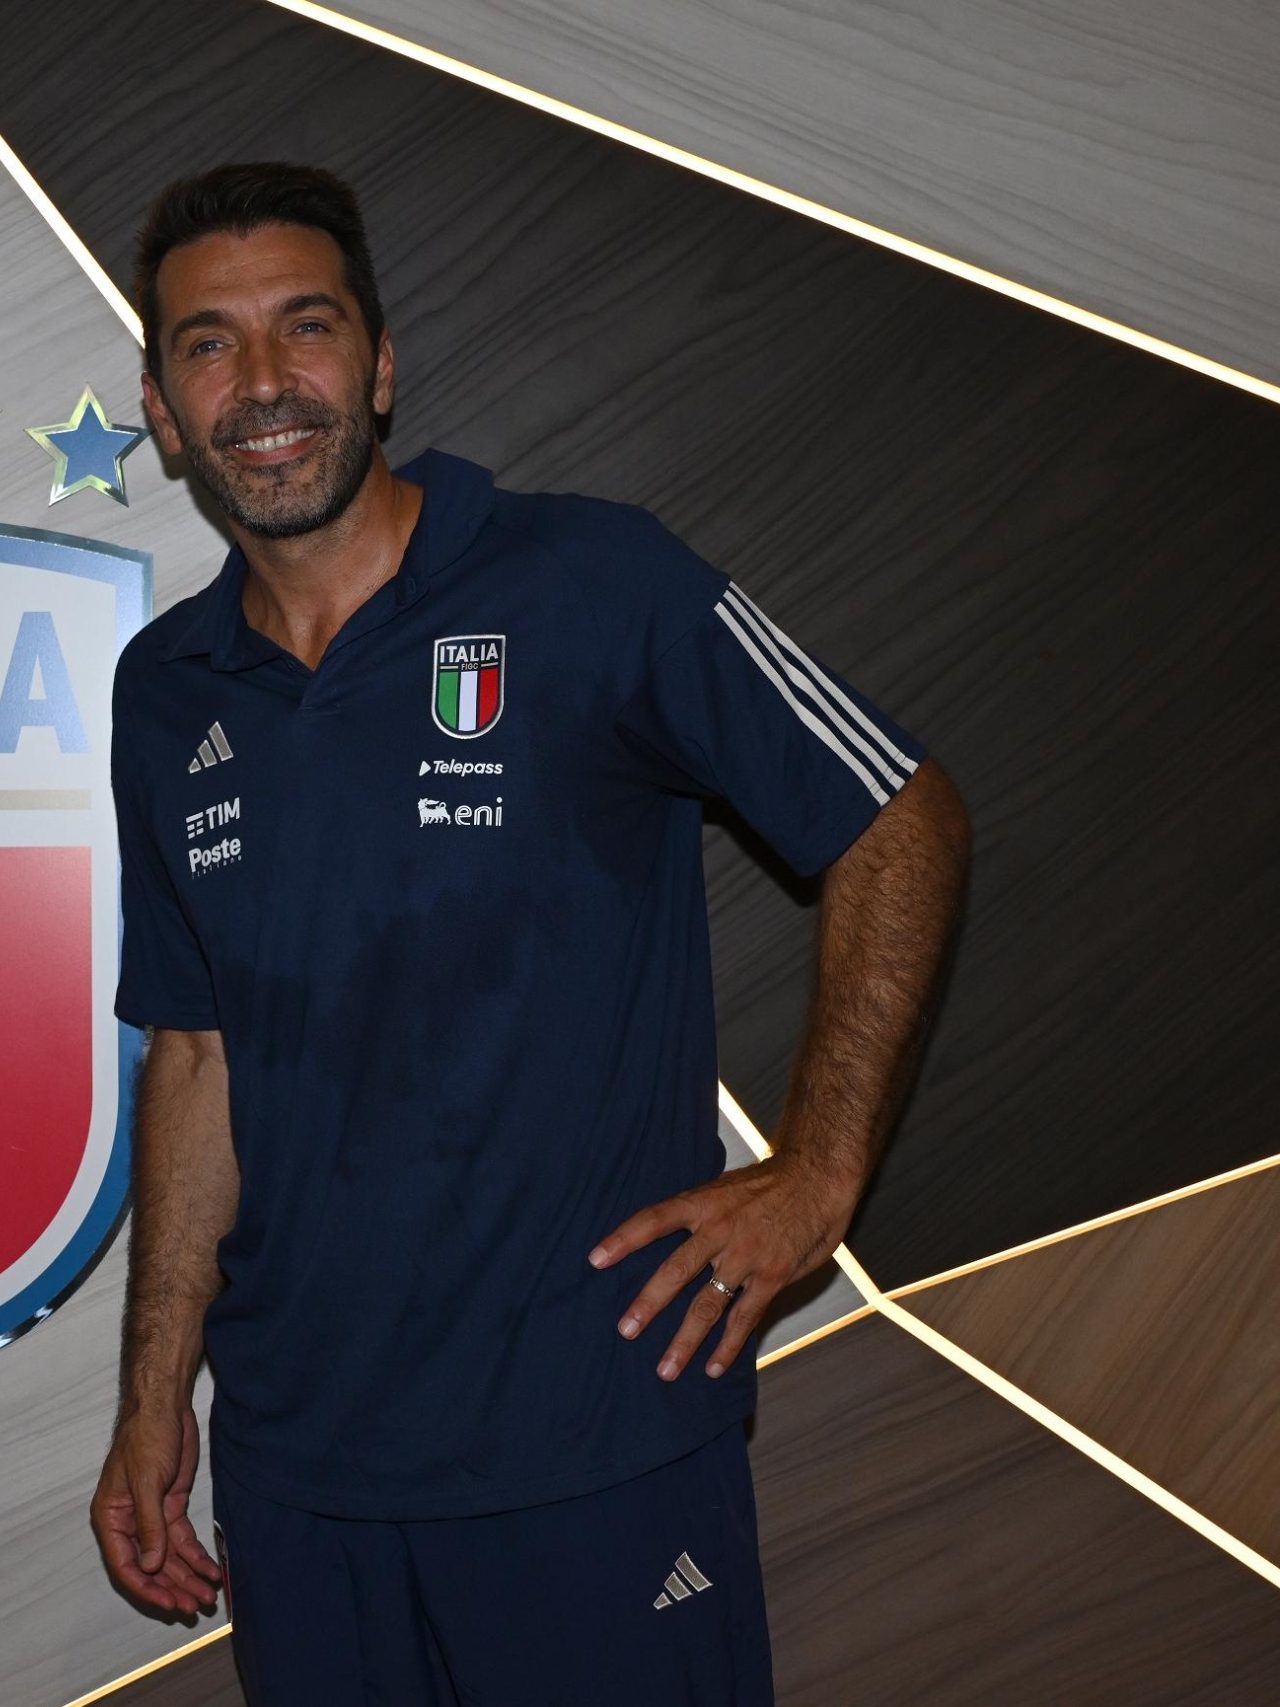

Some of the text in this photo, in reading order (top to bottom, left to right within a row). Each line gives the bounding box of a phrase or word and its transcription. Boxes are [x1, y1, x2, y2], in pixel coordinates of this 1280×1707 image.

[439, 642, 499, 663] ITALIA
[461, 662, 479, 671] FIGC
[433, 758, 504, 777] Telepass
[205, 797, 241, 830] TIM
[454, 797, 503, 827] eni
[188, 837, 242, 873] Poste
